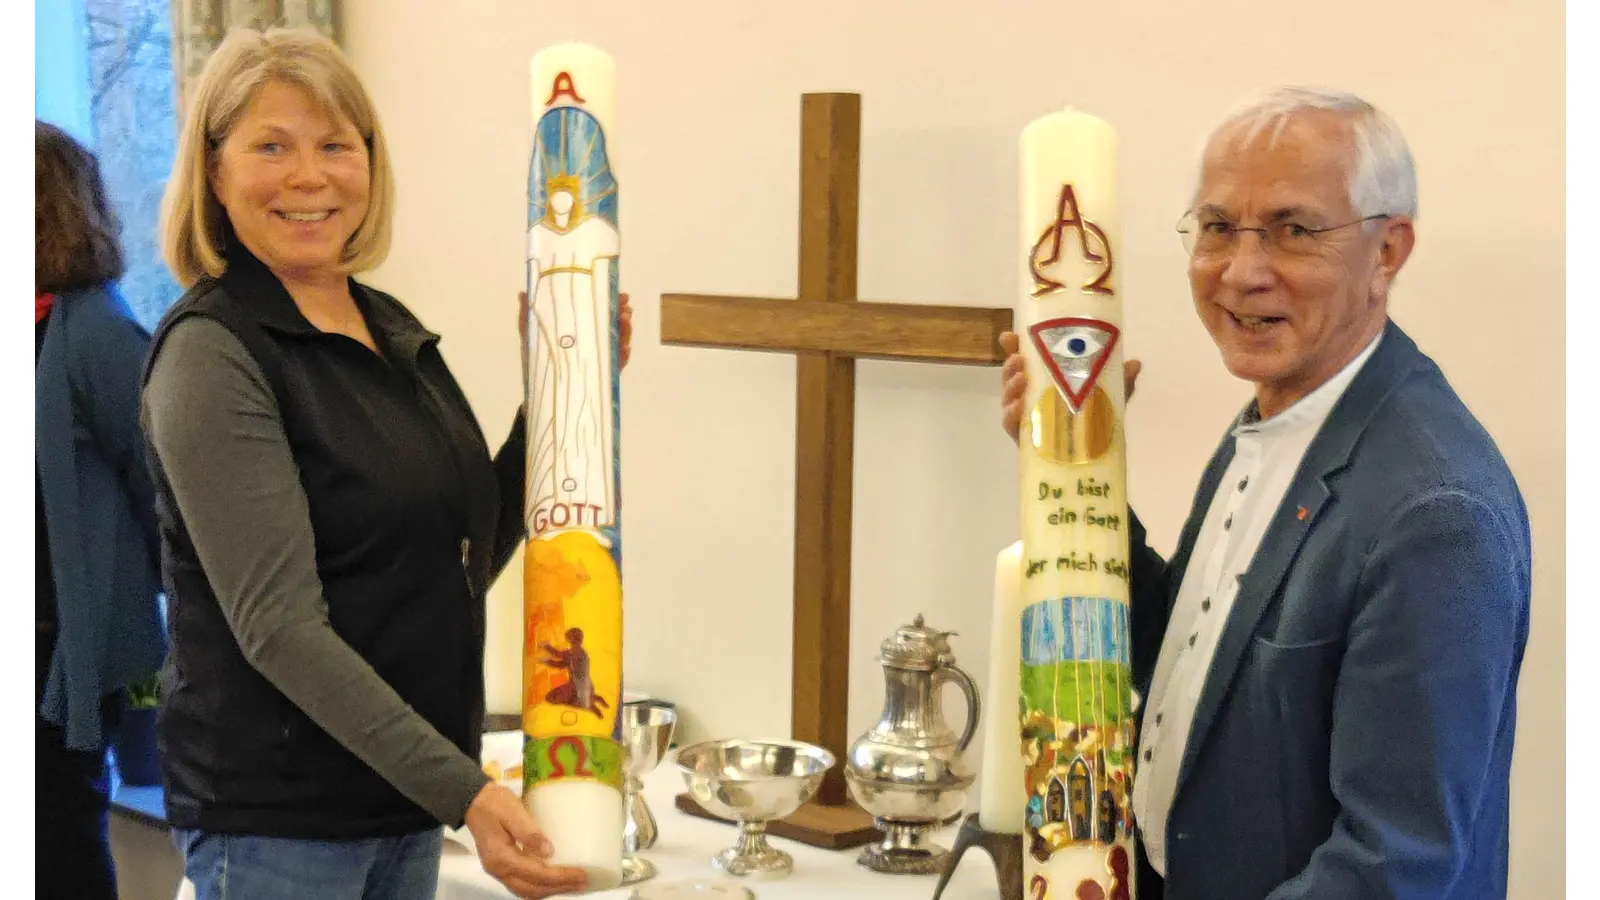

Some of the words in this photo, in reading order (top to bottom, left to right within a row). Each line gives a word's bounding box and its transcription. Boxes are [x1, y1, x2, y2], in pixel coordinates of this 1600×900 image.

[1038, 481, 1063, 501] Du
[1076, 477, 1111, 499] bist
[533, 502, 603, 534] GOTT
[1047, 507, 1077, 526] ein
[1085, 506, 1121, 531] Gott
[1056, 551, 1098, 572] mich
